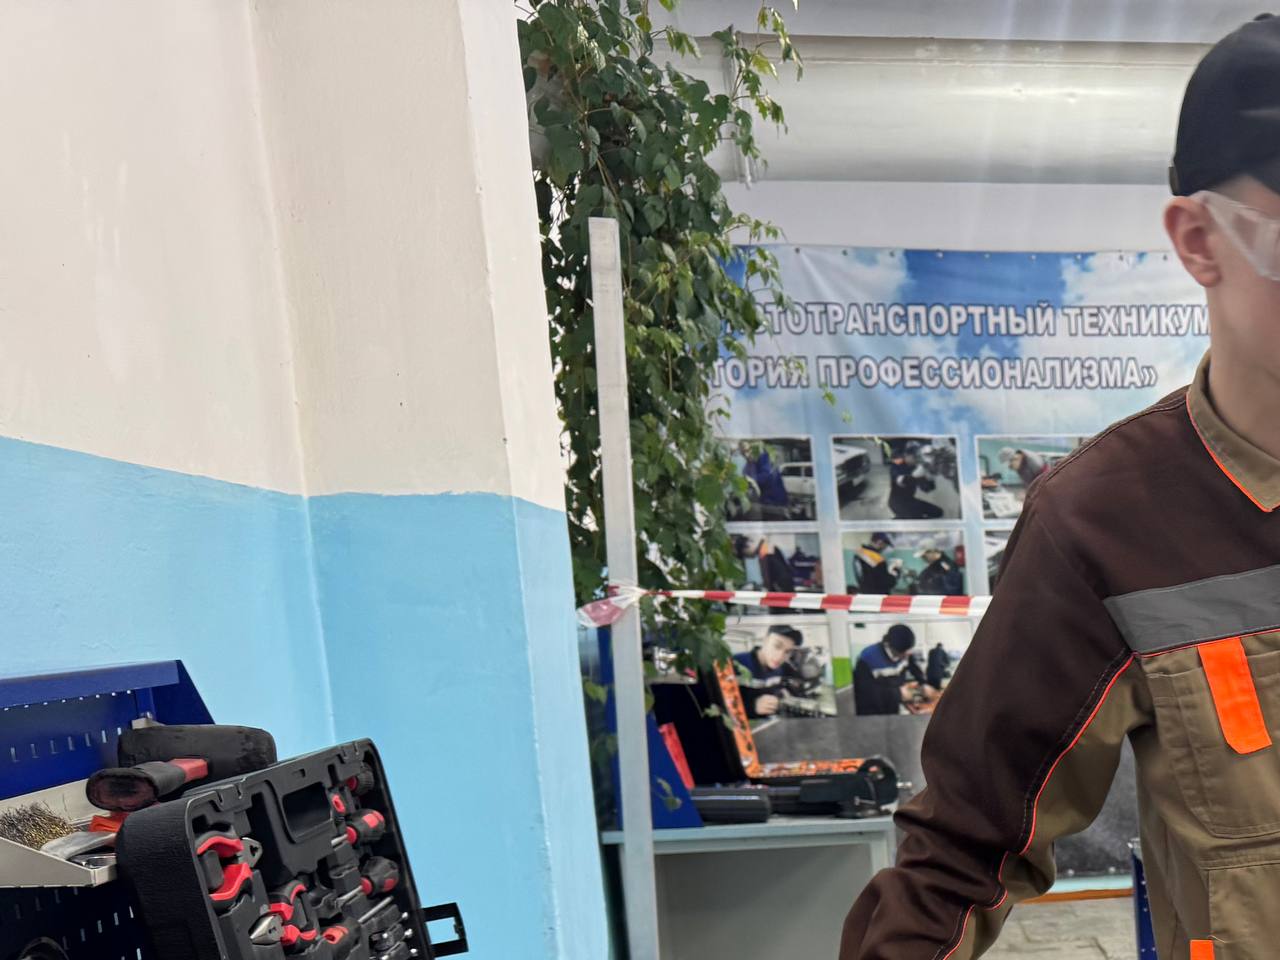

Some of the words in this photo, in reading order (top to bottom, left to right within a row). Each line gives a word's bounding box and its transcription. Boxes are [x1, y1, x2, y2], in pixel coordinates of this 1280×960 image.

[726, 300, 1056, 337] ТОТРАНСПОРТНЫЙ
[1062, 304, 1210, 337] ТЕХНИКУМ
[711, 355, 810, 389] ТОРИЯ
[816, 355, 1158, 389] ПРОФЕССИОНАЛИЗМА»
